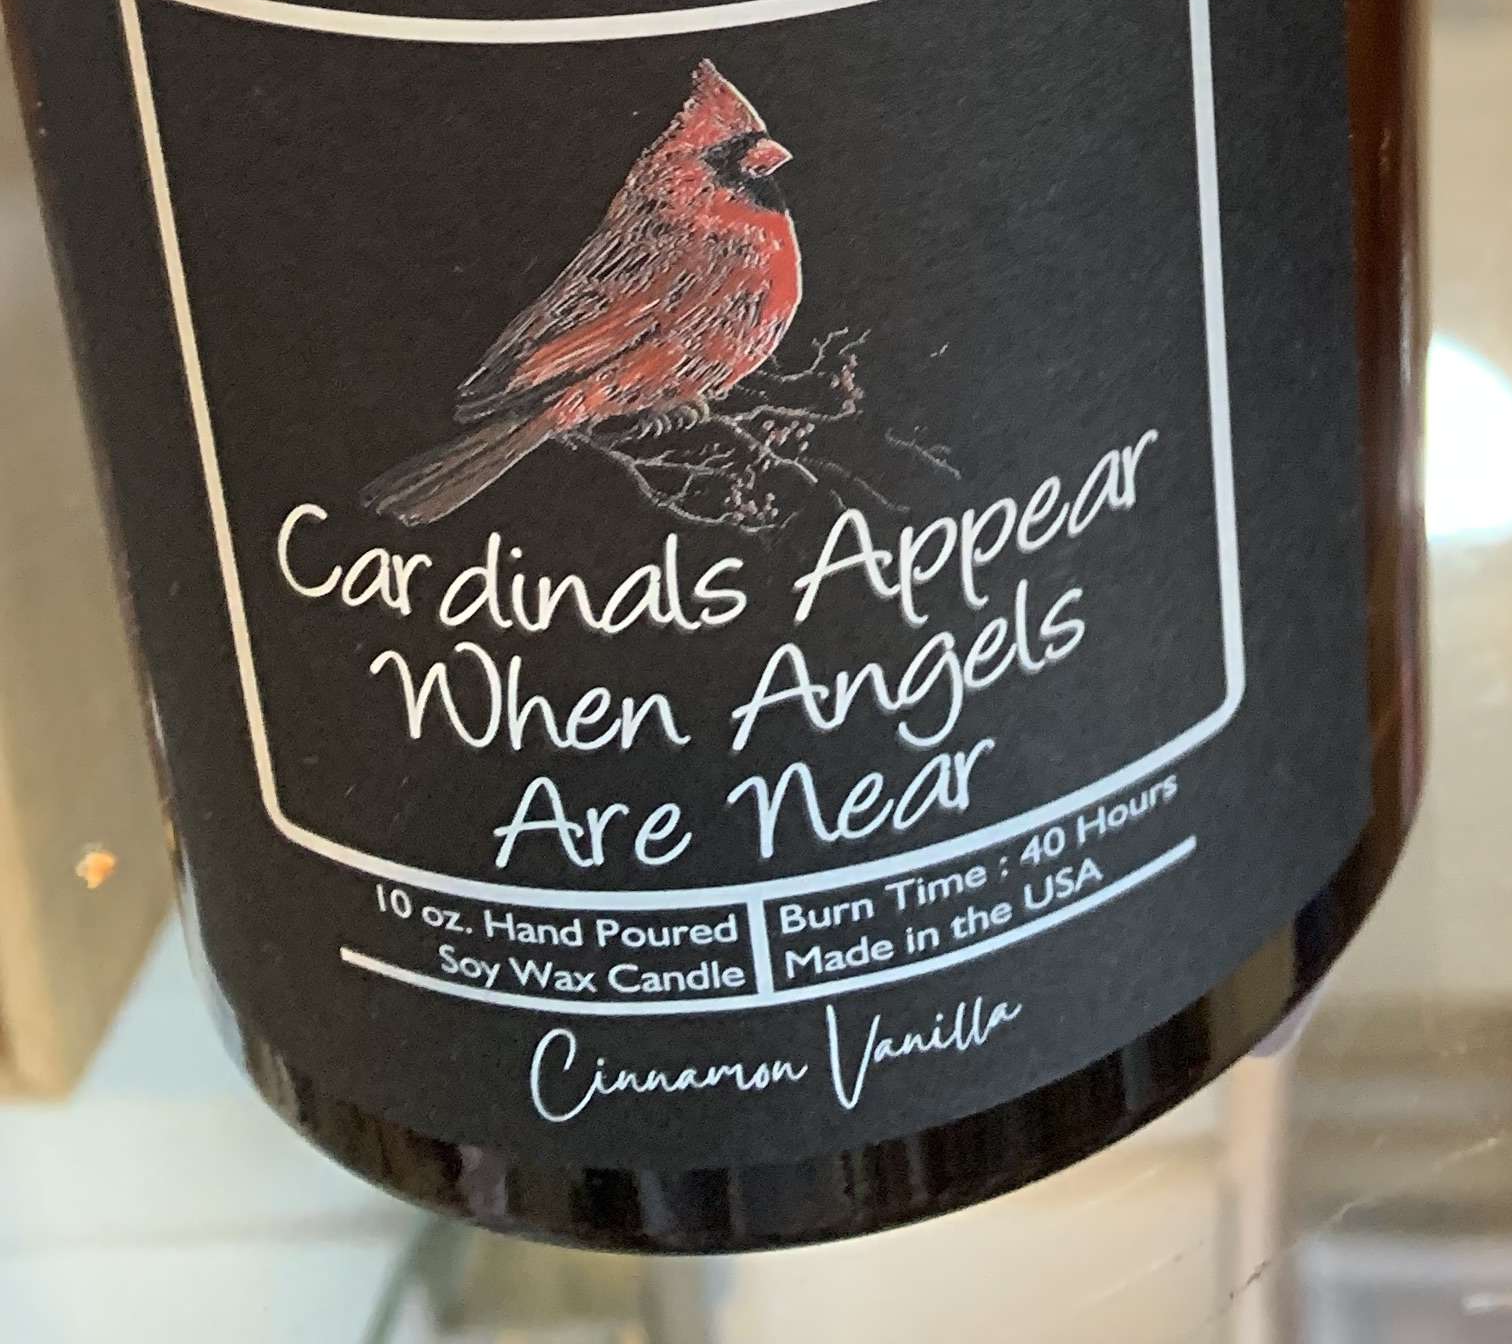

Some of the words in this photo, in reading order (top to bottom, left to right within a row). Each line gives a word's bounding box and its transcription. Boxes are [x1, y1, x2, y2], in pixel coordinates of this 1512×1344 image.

[276, 503, 746, 633] Cardinals
[795, 429, 1158, 621] Appear
[370, 643, 690, 752] When
[732, 580, 1086, 751] Angels
[494, 777, 692, 866] Are
[729, 738, 996, 859] Near
[781, 895, 874, 935] Burn
[886, 861, 988, 913] Time
[1020, 828, 1066, 869] 40
[1076, 772, 1179, 851] Hours
[376, 884, 412, 918] 10
[421, 908, 472, 936] oz.
[485, 912, 584, 948] Hand
[597, 915, 738, 946] Poured
[440, 944, 500, 987] Soy
[512, 956, 597, 994] Wax
[607, 959, 746, 994] Candle
[786, 940, 896, 981] Made
[906, 927, 939, 954] in
[951, 903, 1012, 943] the
[1022, 857, 1104, 910] USA
[530, 1028, 809, 1122] Cinnamon
[826, 992, 1022, 1110] Vanilla
